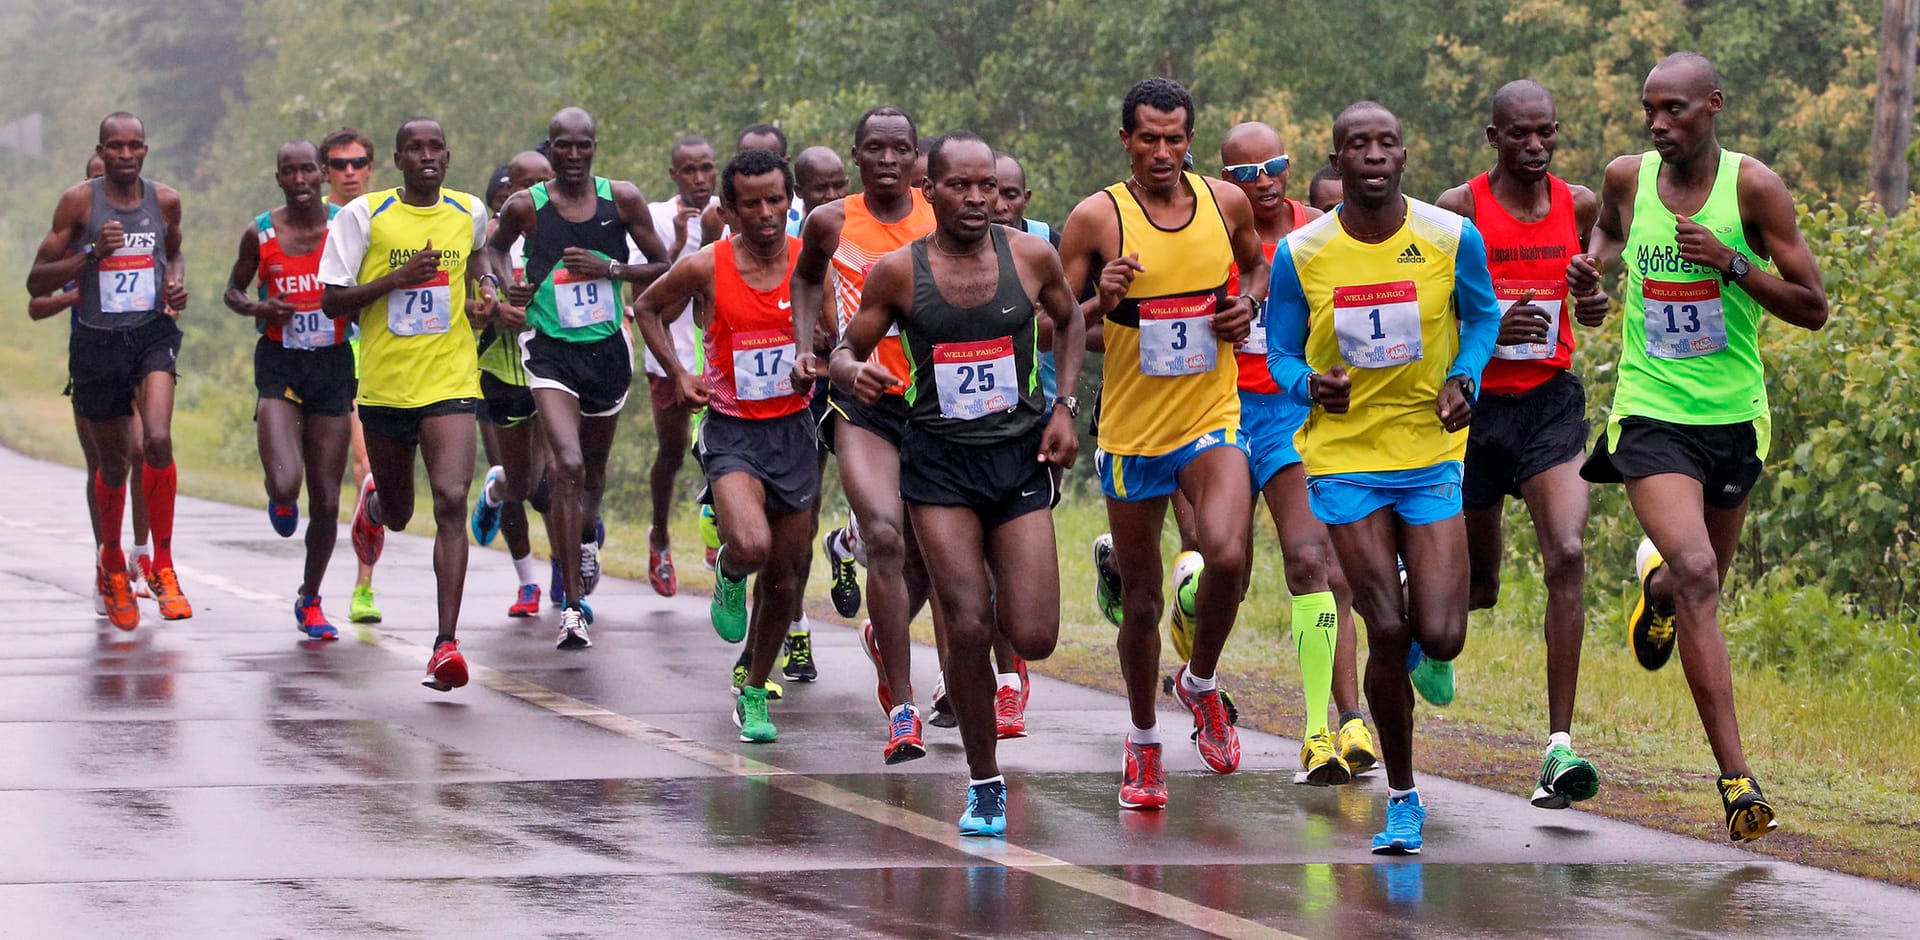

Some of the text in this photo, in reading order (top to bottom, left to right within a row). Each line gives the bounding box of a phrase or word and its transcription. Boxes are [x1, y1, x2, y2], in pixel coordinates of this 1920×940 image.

[115, 272, 140, 294] 27
[275, 273, 326, 293] KENY
[1533, 288, 1555, 296] ARGO
[1650, 287, 1709, 297] WELLS FARGO
[404, 289, 433, 315] 79
[572, 282, 599, 307] 19
[1343, 289, 1406, 302] WELLS FARGO
[1149, 304, 1207, 315] WELLS FARGO
[1663, 304, 1701, 334] 13
[294, 312, 320, 334] 30
[1368, 308, 1386, 340] 1
[741, 338, 768, 346] WELLS
[1170, 321, 1188, 350] 3
[754, 349, 783, 377] 17
[943, 346, 1003, 359] WELLS FARGO
[957, 363, 995, 394] 25
